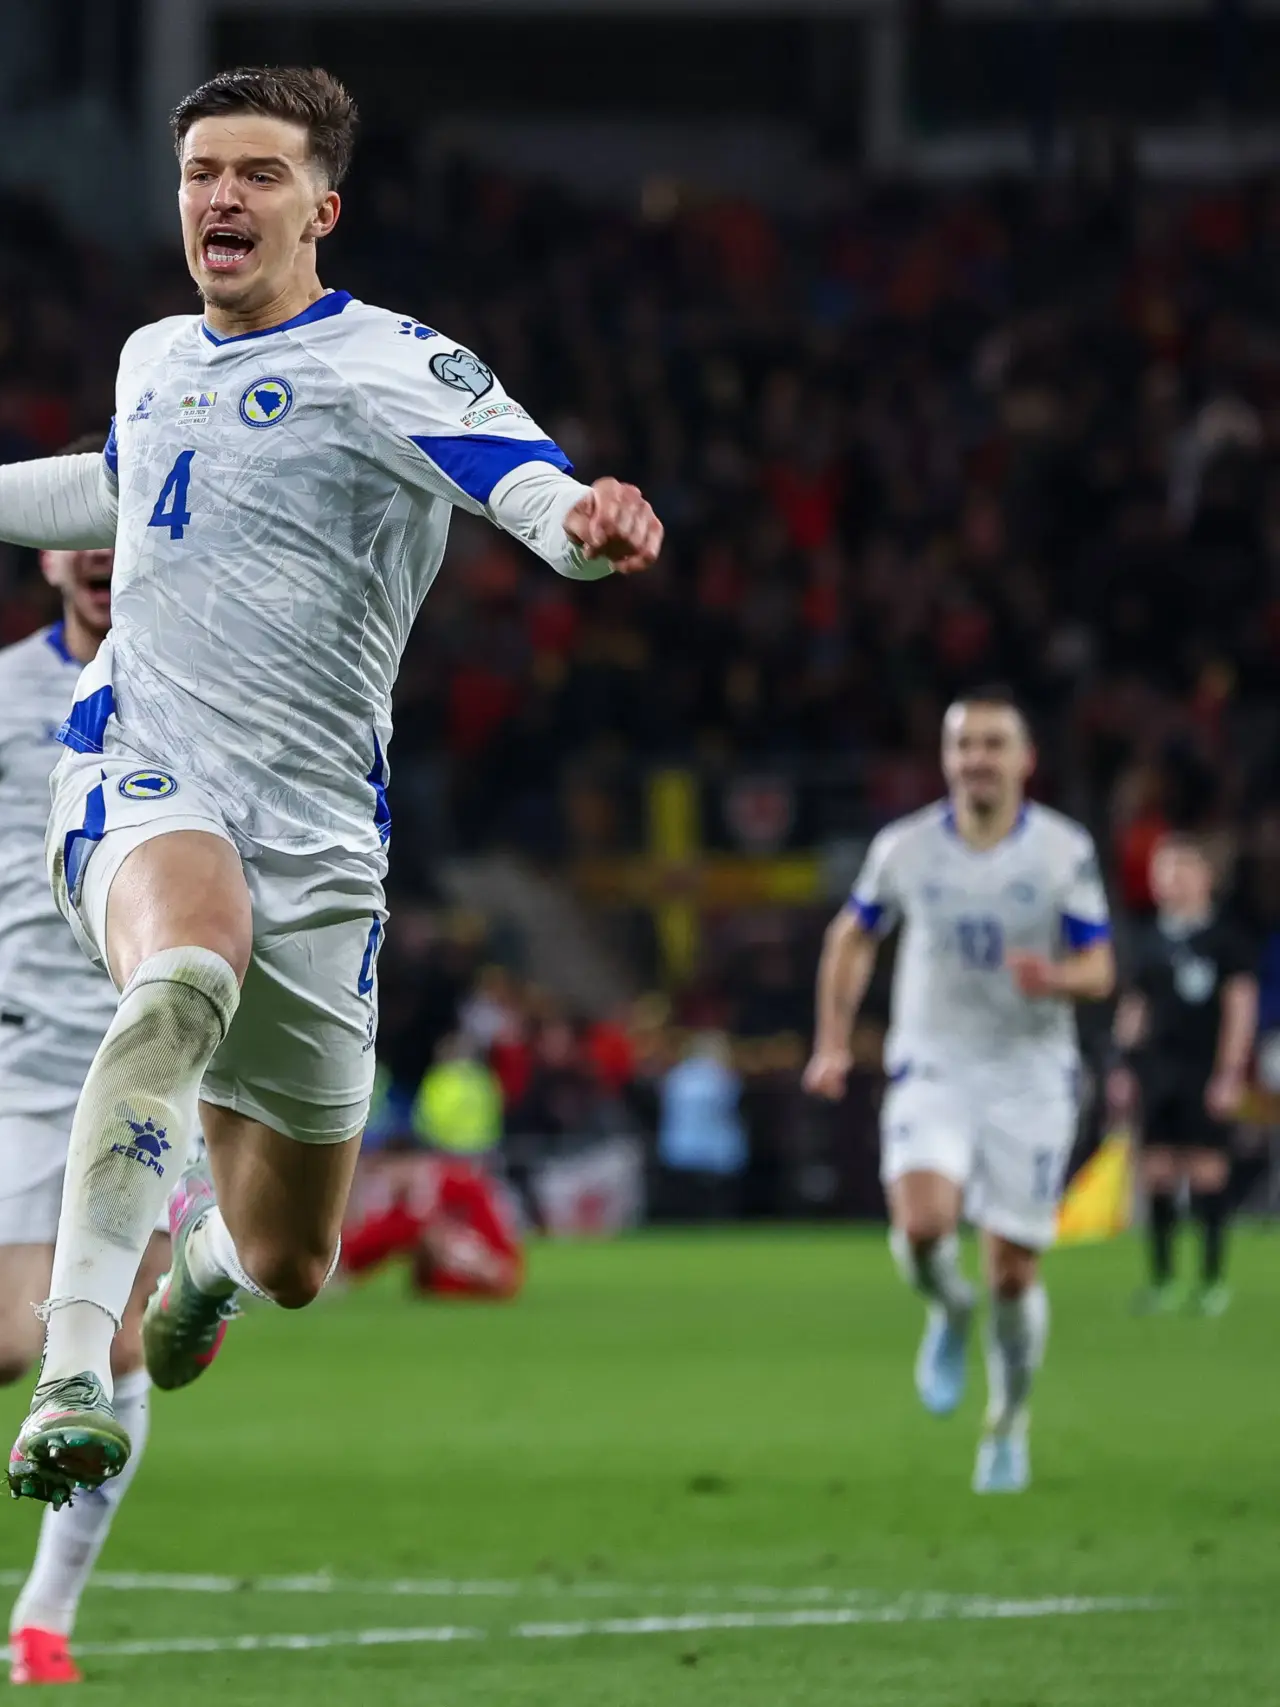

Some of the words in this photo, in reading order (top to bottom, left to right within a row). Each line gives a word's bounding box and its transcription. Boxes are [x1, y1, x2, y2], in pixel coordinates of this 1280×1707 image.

[460, 411, 477, 422] UEFA
[147, 450, 197, 540] 4
[110, 1142, 165, 1179] KELME
